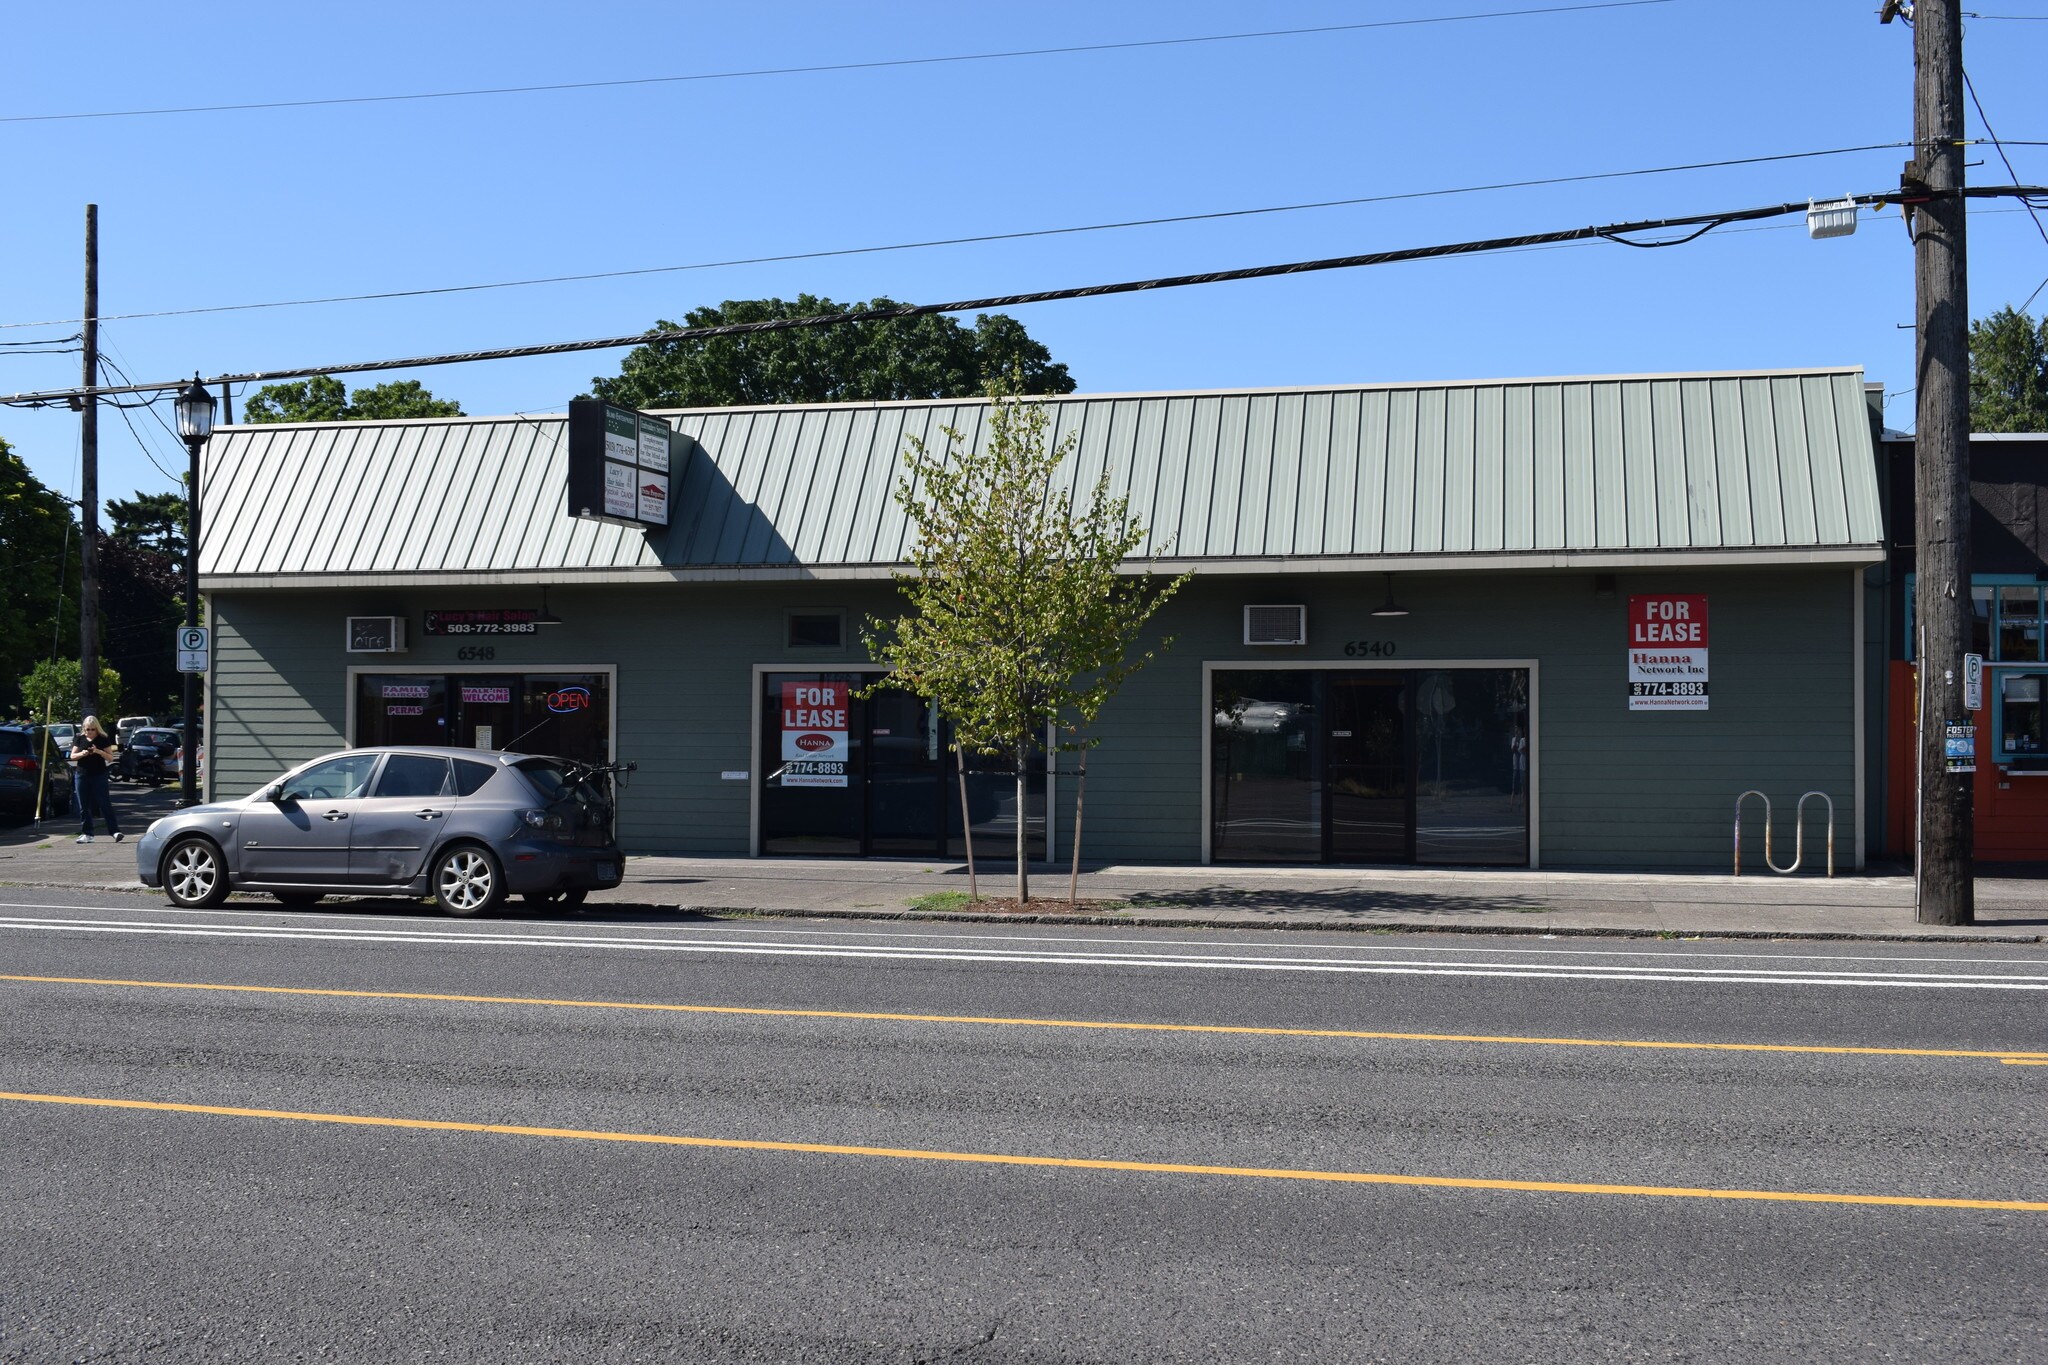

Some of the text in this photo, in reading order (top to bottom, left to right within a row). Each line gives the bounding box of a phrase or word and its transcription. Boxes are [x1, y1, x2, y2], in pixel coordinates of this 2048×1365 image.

[478, 611, 499, 621] Hair
[503, 609, 535, 621] Salon
[1646, 601, 1690, 620] FOR
[447, 624, 535, 633] 503-772-3983
[1635, 623, 1701, 641] LEASE
[189, 634, 199, 646] P
[457, 646, 495, 660] 6548
[1344, 641, 1396, 656] 6540
[1633, 653, 1692, 665] Hanna
[1638, 666, 1704, 674] Network Inc
[1971, 662, 1977, 676] P
[1643, 683, 1703, 695] 774-8893
[463, 693, 509, 702] WELCOME
[547, 692, 589, 708] OPEN
[795, 688, 835, 706] FOR
[388, 706, 423, 715] PERMS
[785, 709, 846, 728] LEASE
[793, 763, 844, 775] 774-8893
